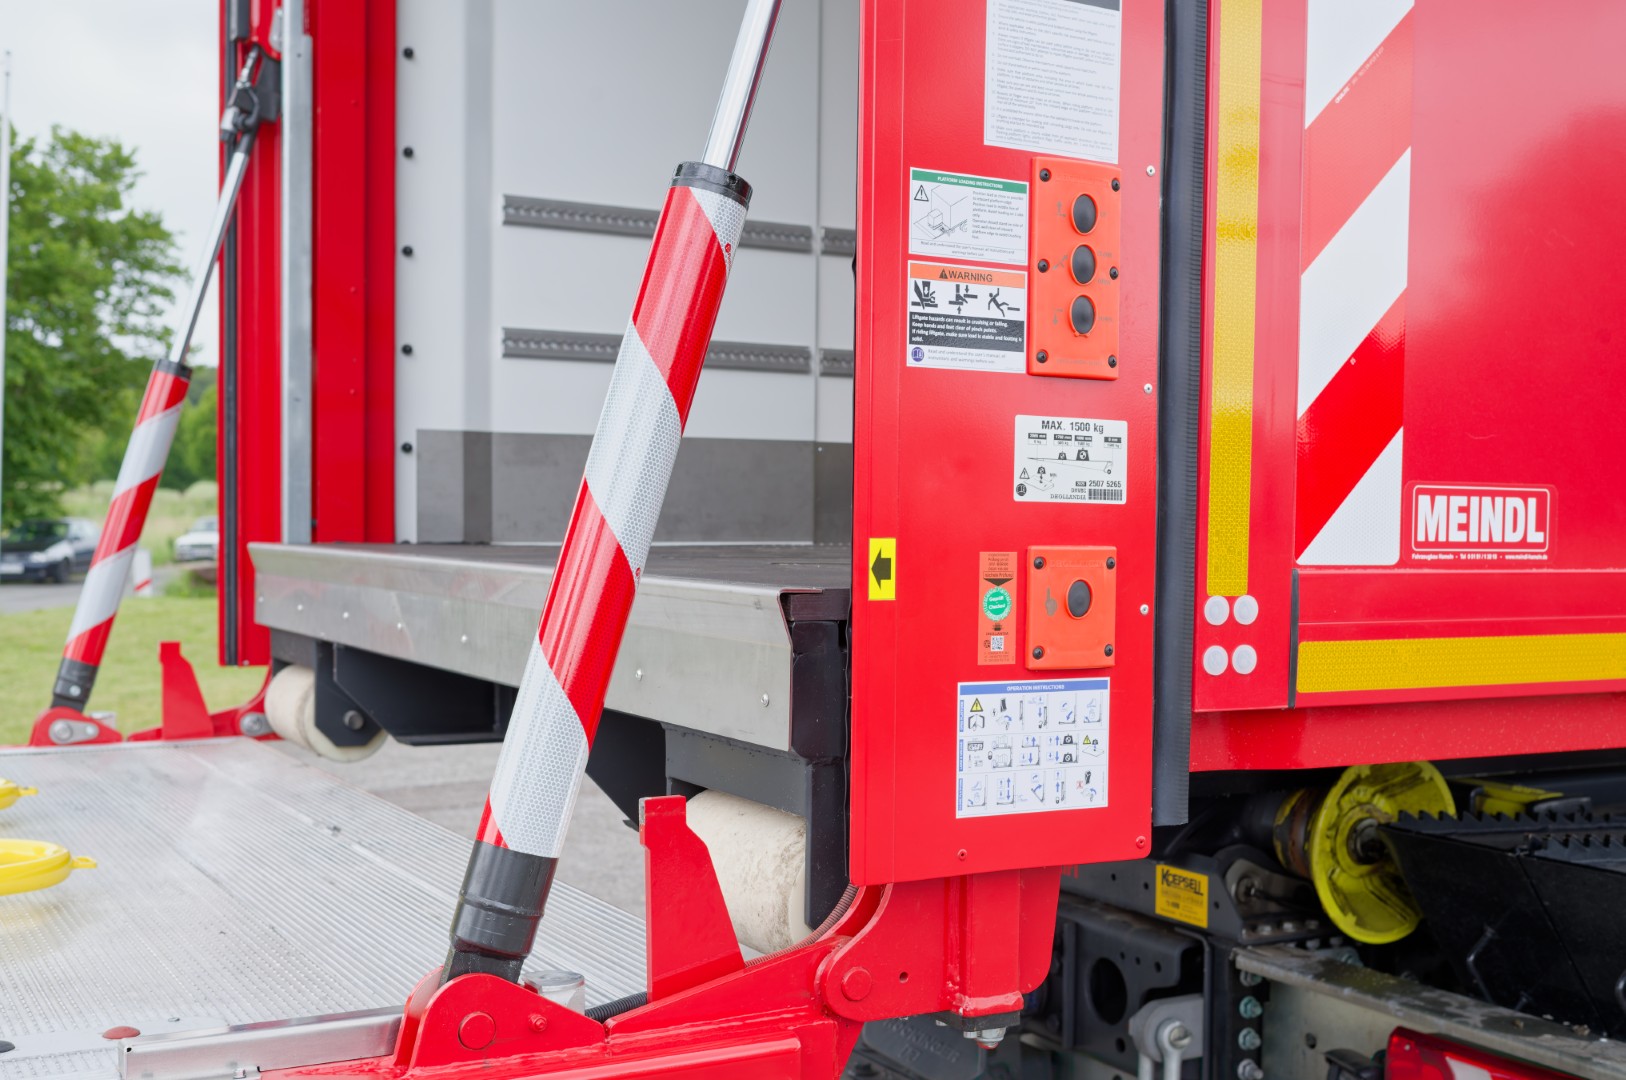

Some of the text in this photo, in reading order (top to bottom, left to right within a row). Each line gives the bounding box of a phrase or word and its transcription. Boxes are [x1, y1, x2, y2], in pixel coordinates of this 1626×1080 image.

[948, 270, 993, 282] WARNING
[1042, 420, 1104, 434] MAX. 1500 kg
[1417, 495, 1544, 543] MEINDL
